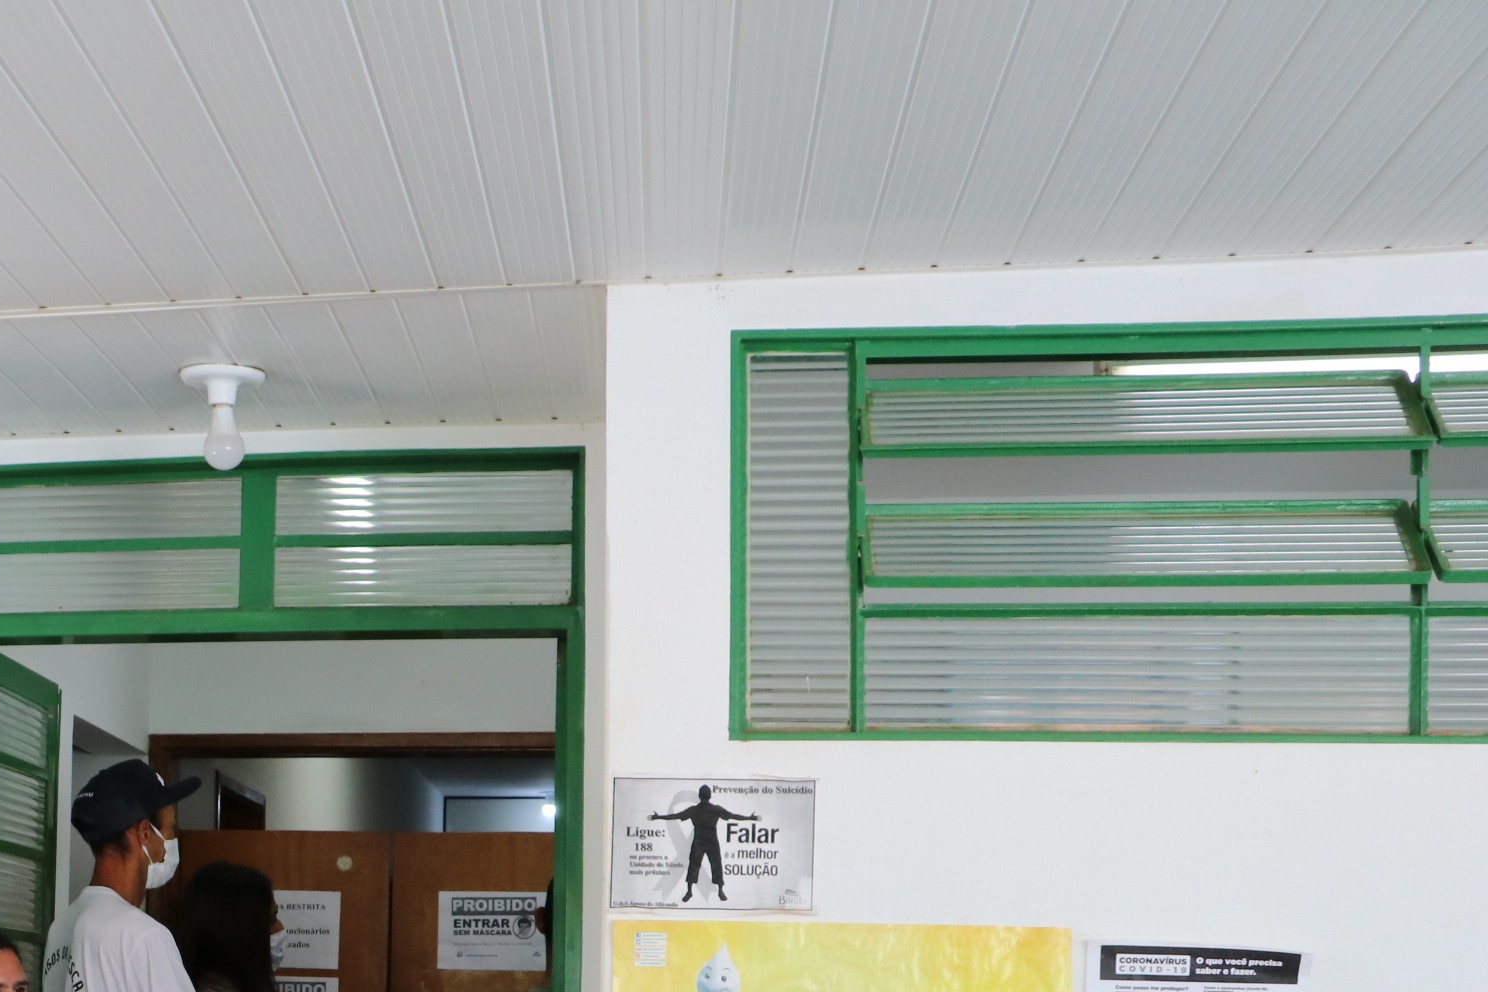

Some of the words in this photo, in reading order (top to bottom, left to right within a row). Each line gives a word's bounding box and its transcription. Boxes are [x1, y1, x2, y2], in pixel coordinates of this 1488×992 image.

[712, 785, 759, 796] Prevenção
[762, 786, 773, 794] do
[776, 786, 813, 795] Suicídio
[626, 826, 666, 839] Ligue:
[726, 822, 780, 844] Falar
[634, 842, 653, 852] 188
[724, 850, 730, 859] é
[737, 848, 778, 860] melhor
[724, 862, 778, 879] SOLUÇÃO
[286, 903, 326, 911] RESTRITA
[452, 898, 537, 912] PROIBIDO
[453, 918, 510, 928] ENTRAR
[472, 928, 512, 936] MÁSCARA
[1119, 955, 1188, 966] CORONAVÍRUS
[1196, 956, 1204, 965] O
[1205, 958, 1223, 967] que
[1224, 956, 1247, 966] você
[1248, 958, 1284, 968] precisa
[1118, 965, 1188, 974] COVID-19
[1196, 966, 1222, 976] saber
[1230, 966, 1257, 976] fazer.
